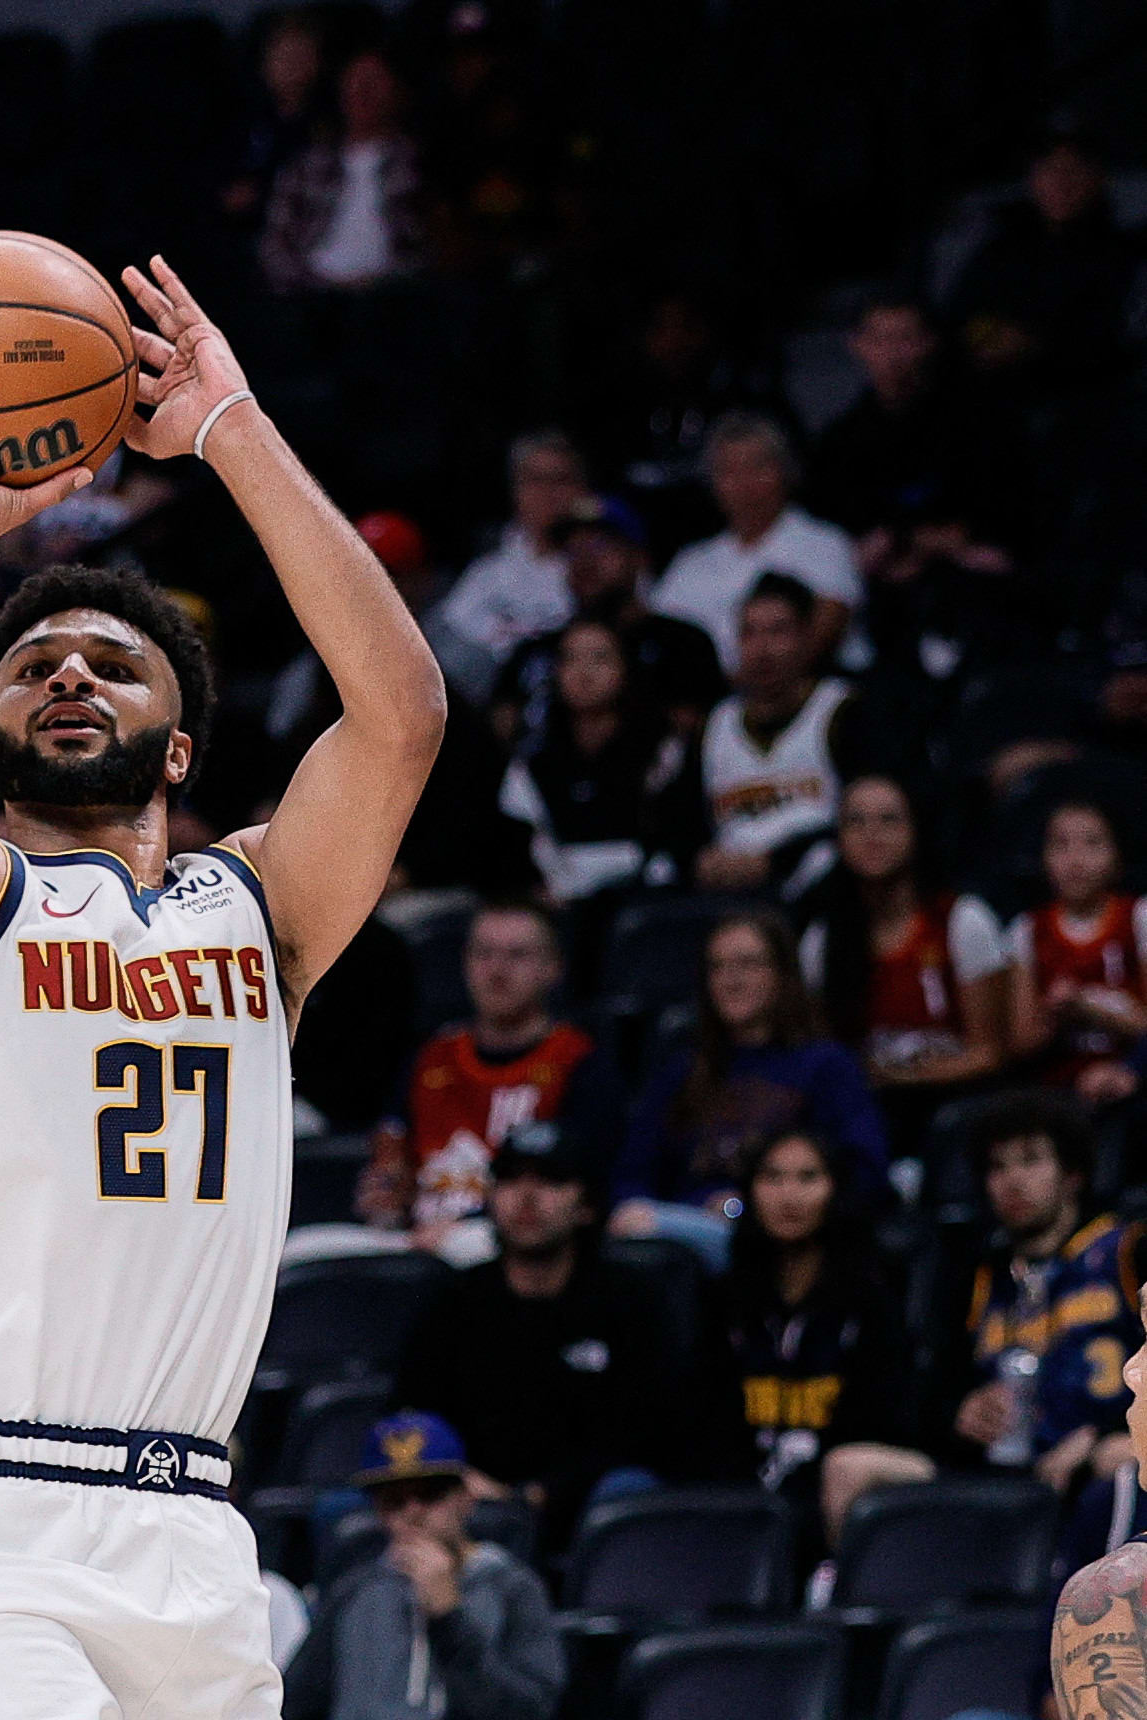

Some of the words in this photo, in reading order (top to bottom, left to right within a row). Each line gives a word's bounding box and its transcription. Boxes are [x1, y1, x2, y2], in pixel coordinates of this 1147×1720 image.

[165, 868, 224, 900] WU
[175, 885, 234, 911] Western
[191, 897, 232, 915] Union
[92, 1037, 233, 1204] 27
